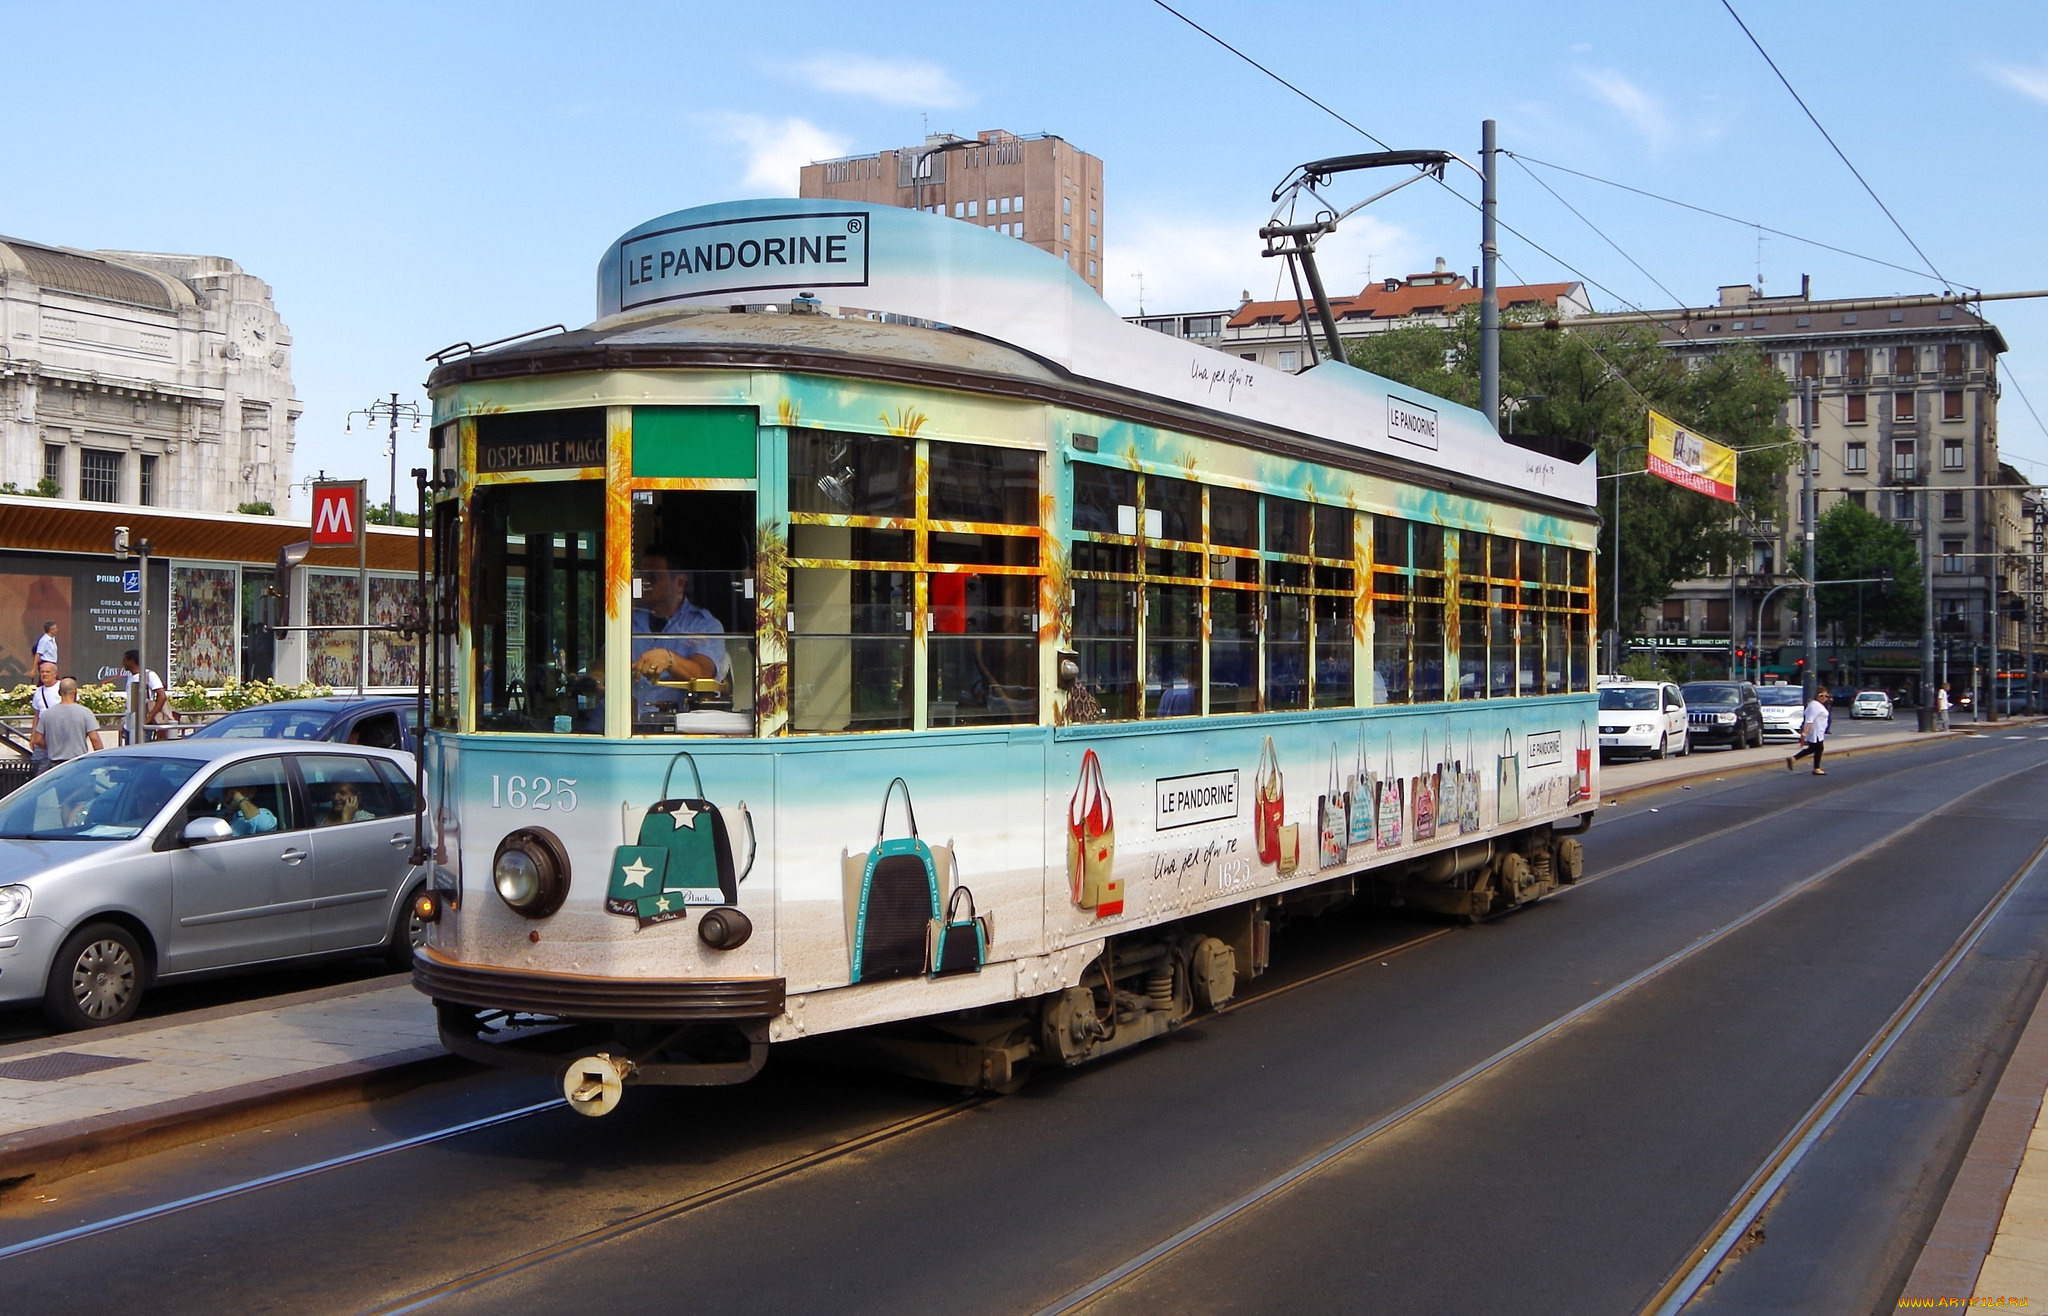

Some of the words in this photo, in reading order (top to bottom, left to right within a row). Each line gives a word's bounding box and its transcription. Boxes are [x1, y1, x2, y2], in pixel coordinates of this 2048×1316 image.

[629, 255, 653, 286] LE
[1191, 359, 1208, 380] Una
[1391, 408, 1399, 426] LE
[1400, 412, 1435, 438] PANDORINE
[487, 441, 560, 469] OSPEDALE
[315, 497, 353, 533] M
[2035, 504, 2043, 578] AMADEUS
[96, 574, 120, 583] PRIMO
[2035, 585, 2043, 633] HOTEL
[491, 774, 578, 813] 1625
[1162, 793, 1175, 814] LE
[1154, 854, 1177, 880] Una
[1218, 857, 1251, 890] 1625
